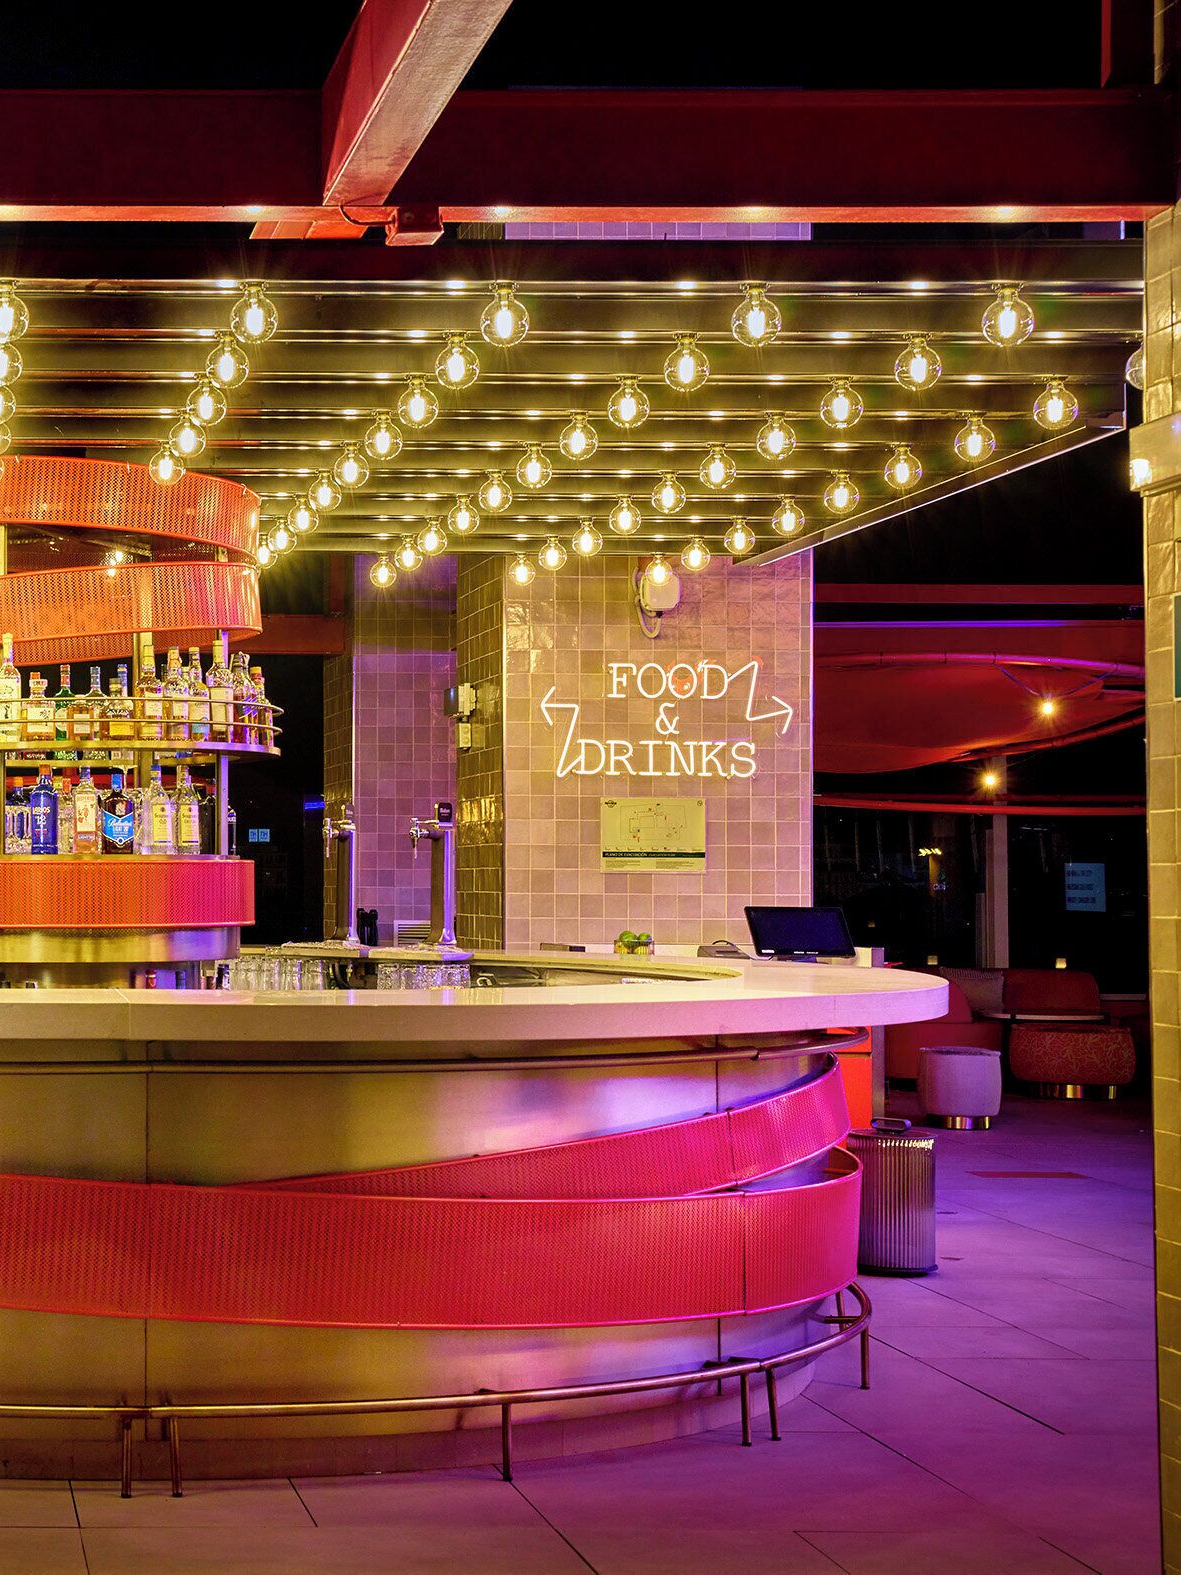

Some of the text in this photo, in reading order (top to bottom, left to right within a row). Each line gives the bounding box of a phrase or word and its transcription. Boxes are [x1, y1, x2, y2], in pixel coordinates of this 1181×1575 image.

[607, 662, 728, 700] FOOD
[655, 702, 680, 735] &
[572, 739, 757, 778] DRINKS
